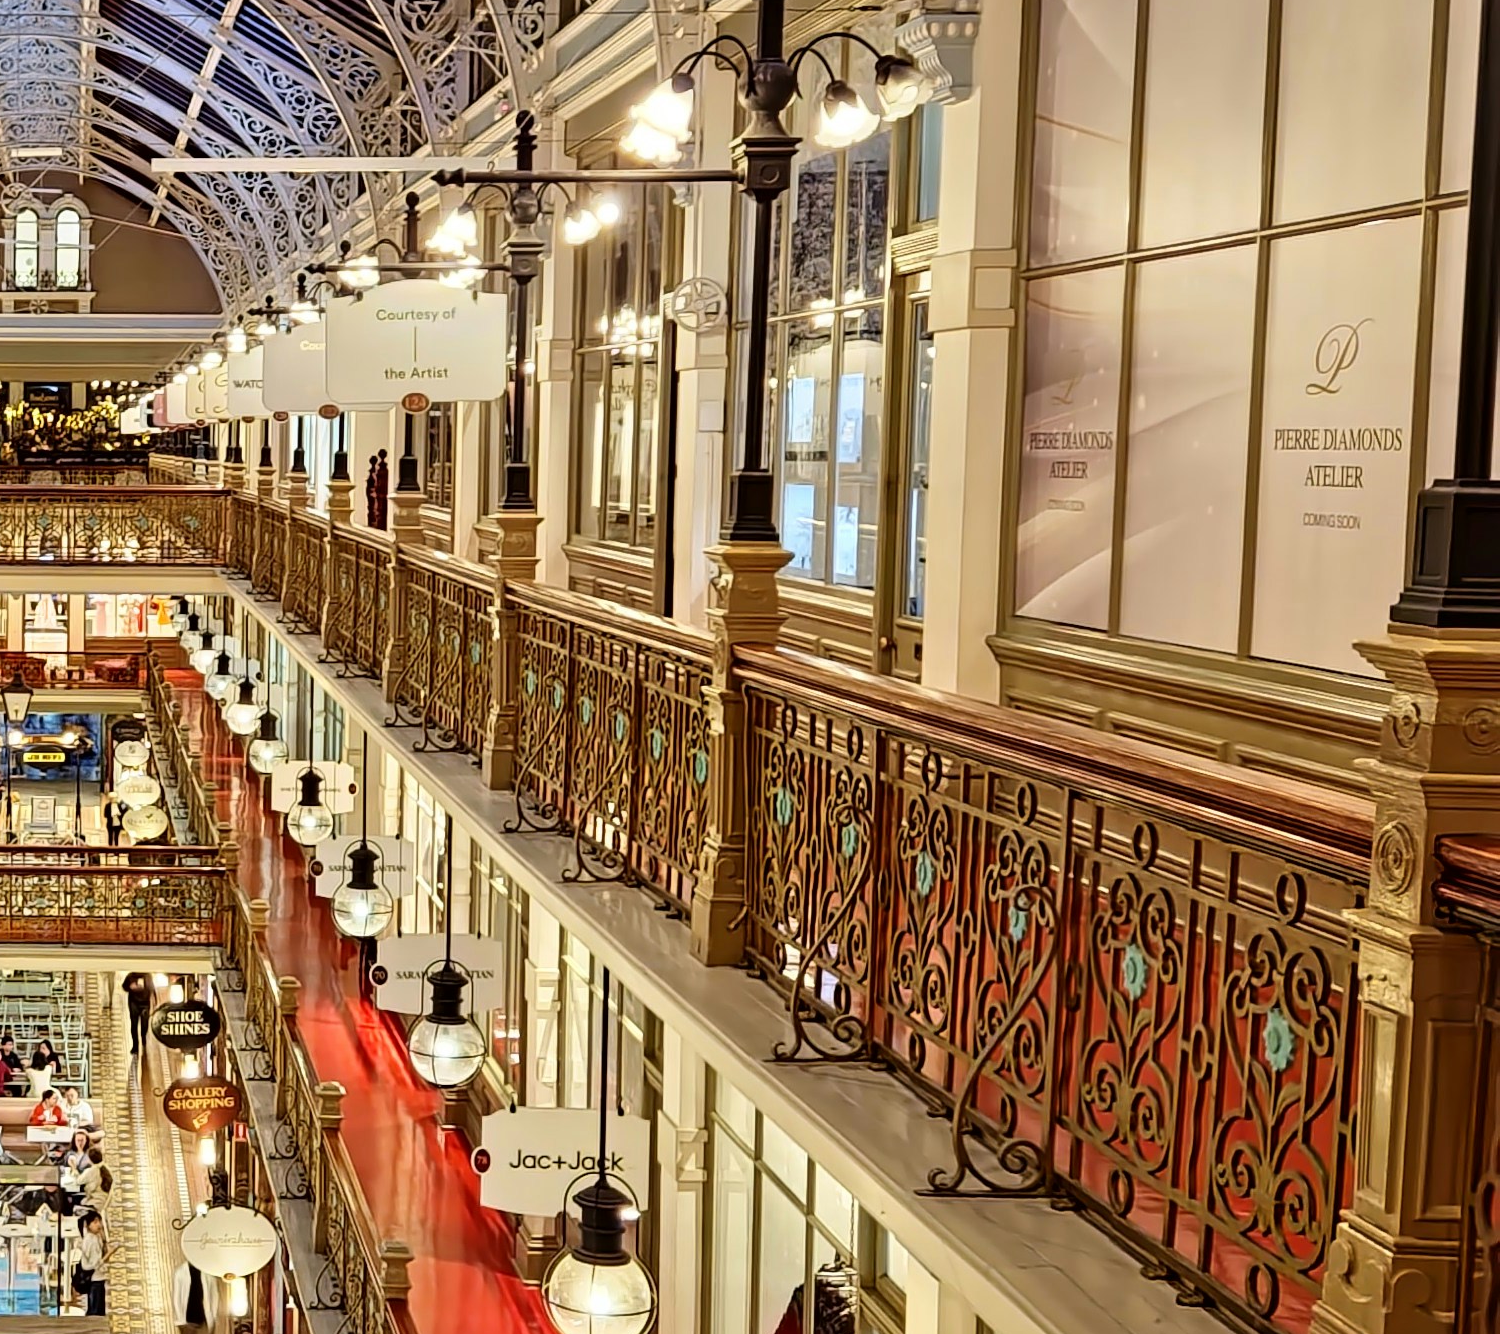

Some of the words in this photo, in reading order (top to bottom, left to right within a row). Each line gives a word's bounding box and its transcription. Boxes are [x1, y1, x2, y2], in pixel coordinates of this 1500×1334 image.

[376, 309, 437, 322] Courtesy
[442, 307, 456, 319] of
[384, 368, 405, 379] the
[410, 367, 448, 379] Artist
[1061, 431, 1113, 450] DIAMONDS
[1274, 428, 1320, 450] PIERRE
[1322, 428, 1403, 451] DIAMONDS
[1049, 461, 1088, 479] ATELIER
[1304, 465, 1363, 488] ATELIER
[167, 1011, 204, 1023] SHOE
[161, 1023, 210, 1036] SHINES
[173, 1087, 227, 1099] GALLERY
[168, 1097, 235, 1110] SHOPPING
[509, 1149, 624, 1172] Jac+Jack
